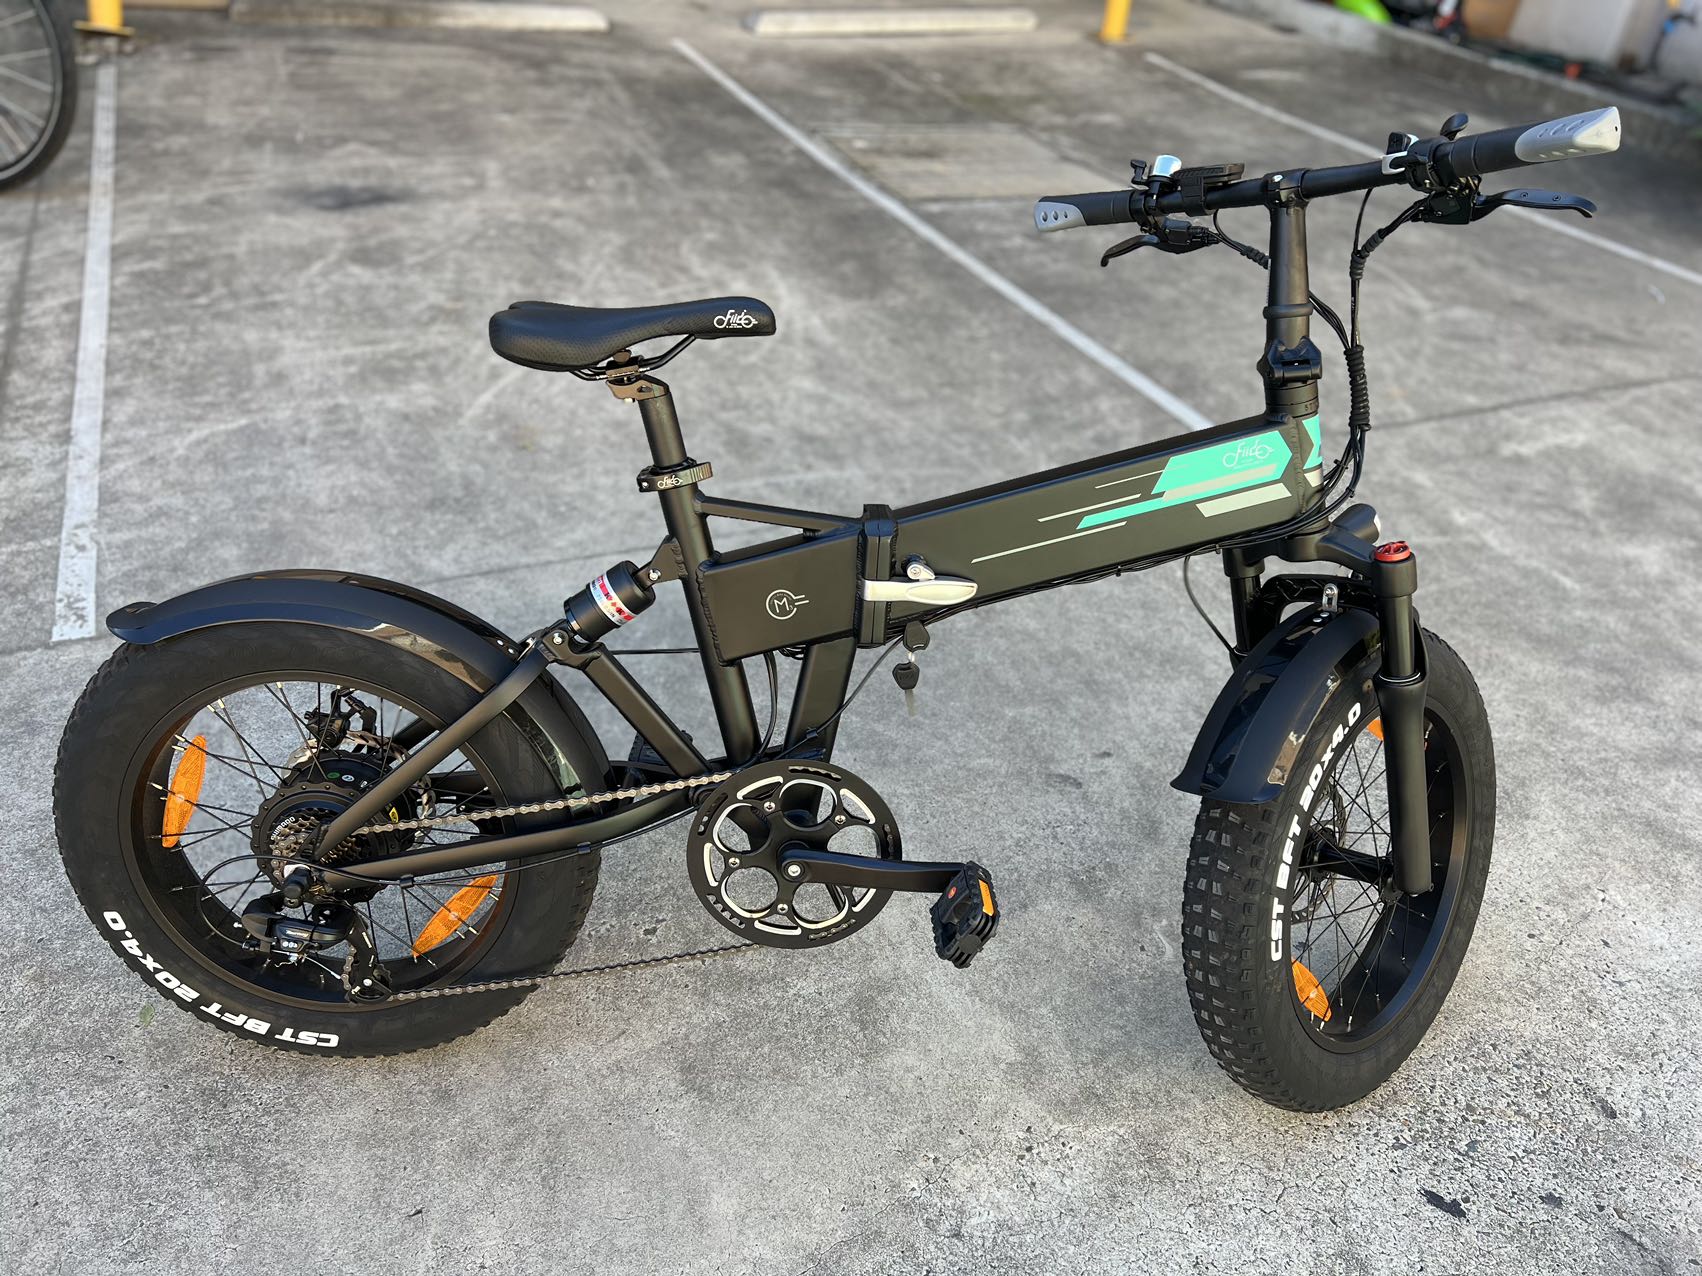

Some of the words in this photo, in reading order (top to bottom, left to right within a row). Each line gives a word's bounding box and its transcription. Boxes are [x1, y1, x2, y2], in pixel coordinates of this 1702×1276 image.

[1276, 814, 1302, 890] BFT
[1271, 897, 1285, 962] CST
[200, 1002, 272, 1035] BFT
[275, 1028, 340, 1048] CST
